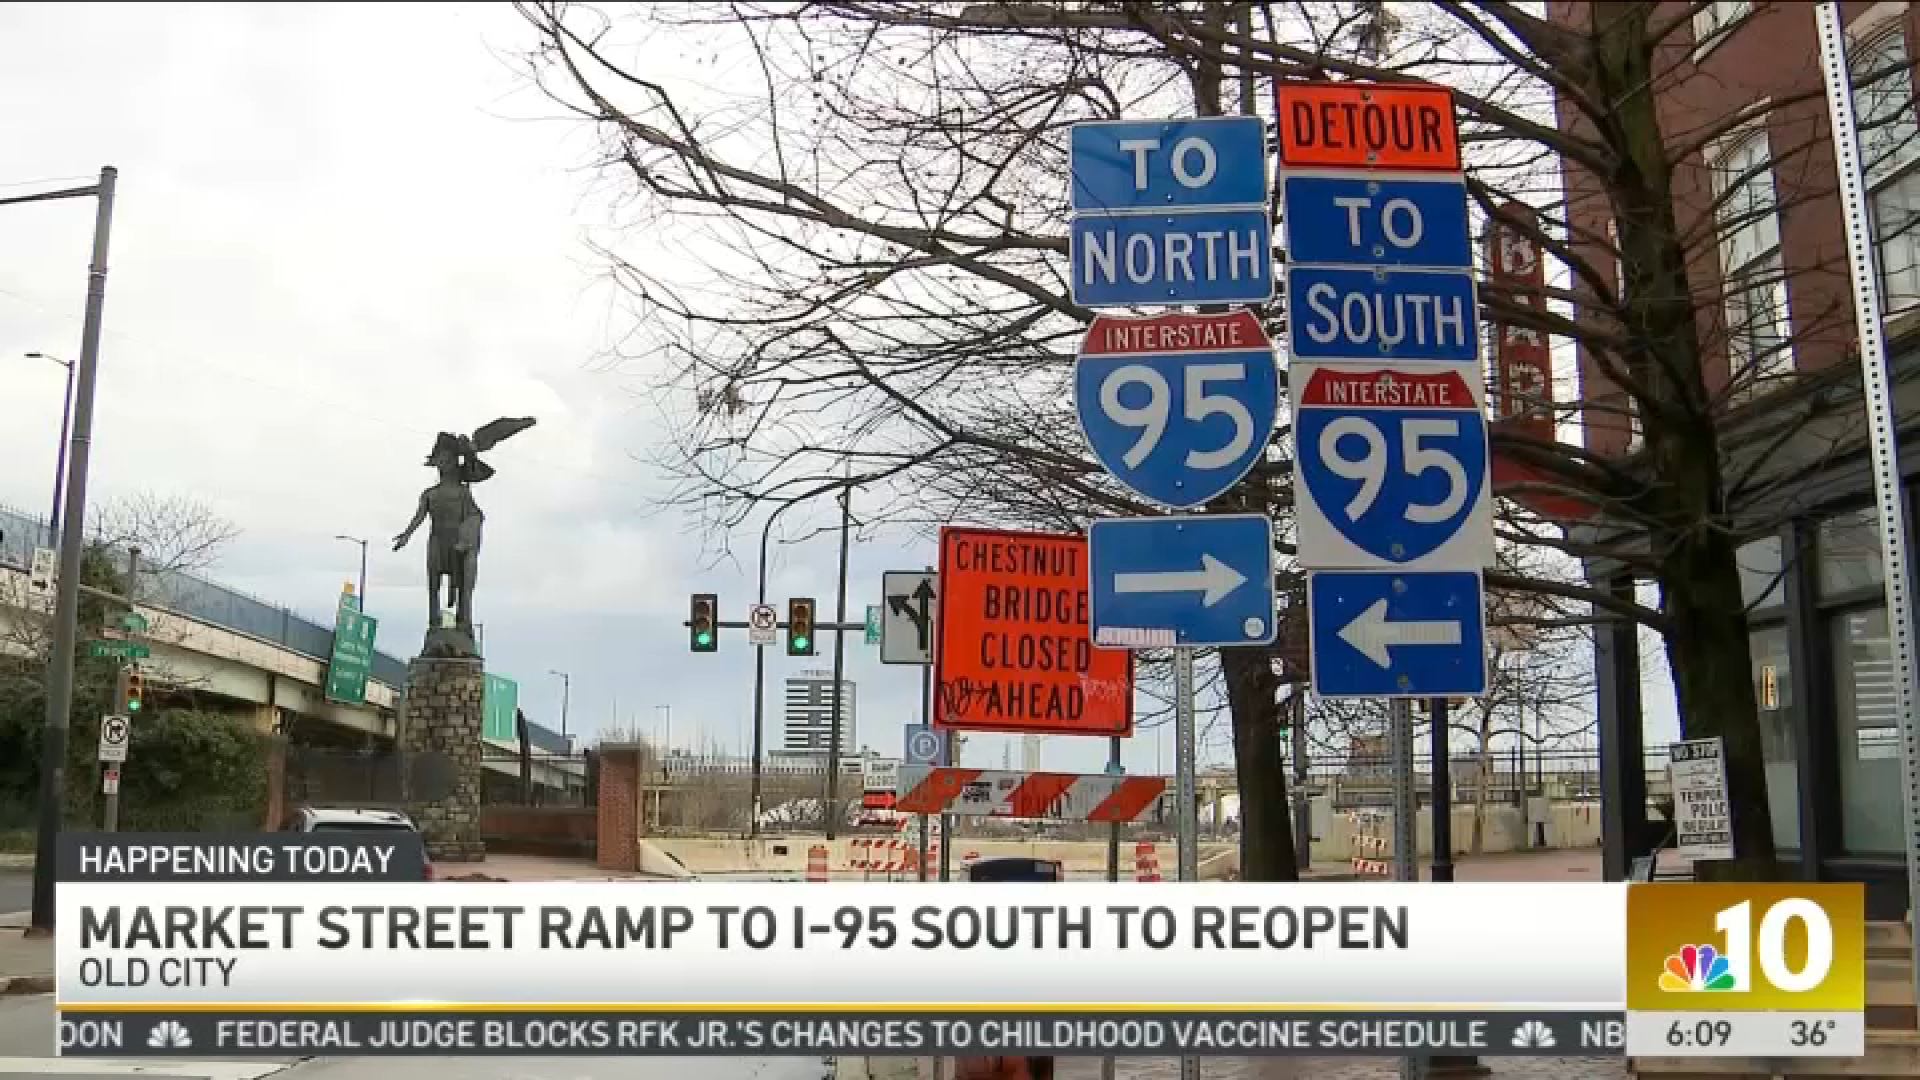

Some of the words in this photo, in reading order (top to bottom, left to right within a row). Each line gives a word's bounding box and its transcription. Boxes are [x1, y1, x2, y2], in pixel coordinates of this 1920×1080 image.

[1292, 99, 1442, 153] DETOUR
[1119, 136, 1217, 190] TO
[1333, 196, 1424, 248] TO
[1083, 229, 1261, 285] NORTH
[1104, 321, 1244, 350] INTERSTATE
[1306, 281, 1464, 346] SOUTH
[1101, 362, 1254, 471] 95
[1324, 380, 1452, 406] INTERSTATE
[1319, 415, 1468, 524] 95
[955, 540, 1078, 577] CHESTNUT
[984, 583, 1089, 625] BRIDGE
[980, 631, 1090, 673] CLOSED
[985, 680, 1084, 721] AHEAD
